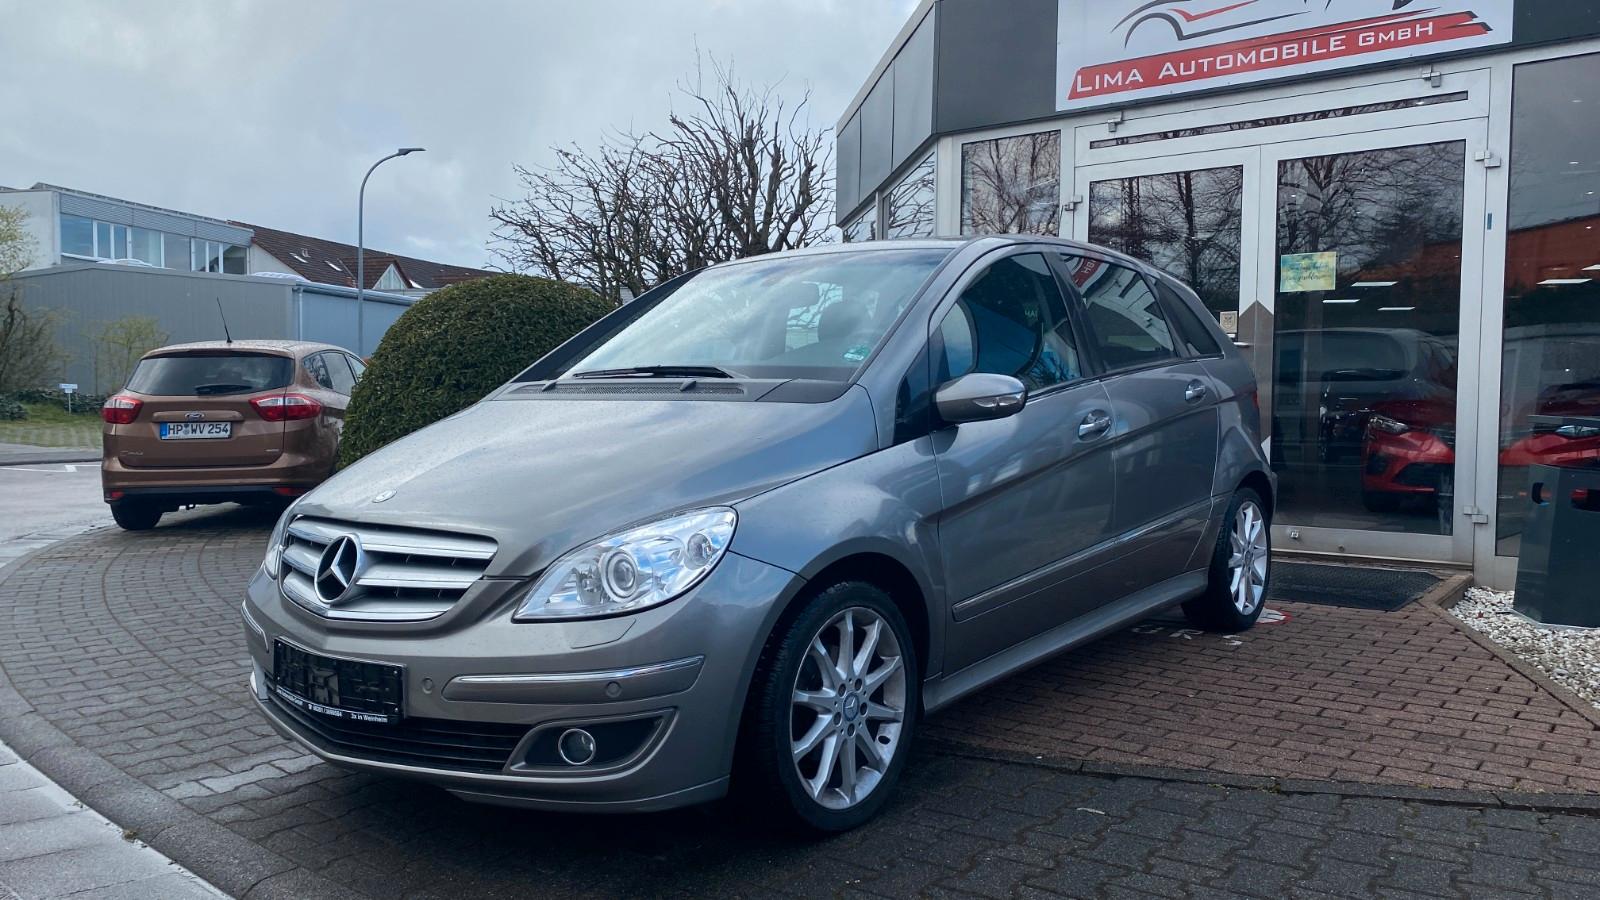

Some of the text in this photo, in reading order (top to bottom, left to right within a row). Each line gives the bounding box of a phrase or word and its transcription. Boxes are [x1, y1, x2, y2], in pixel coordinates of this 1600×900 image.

[1076, 68, 1144, 93] LIMA
[1158, 35, 1346, 80] AUTOMOBILE
[168, 423, 229, 435] HP WV 254
